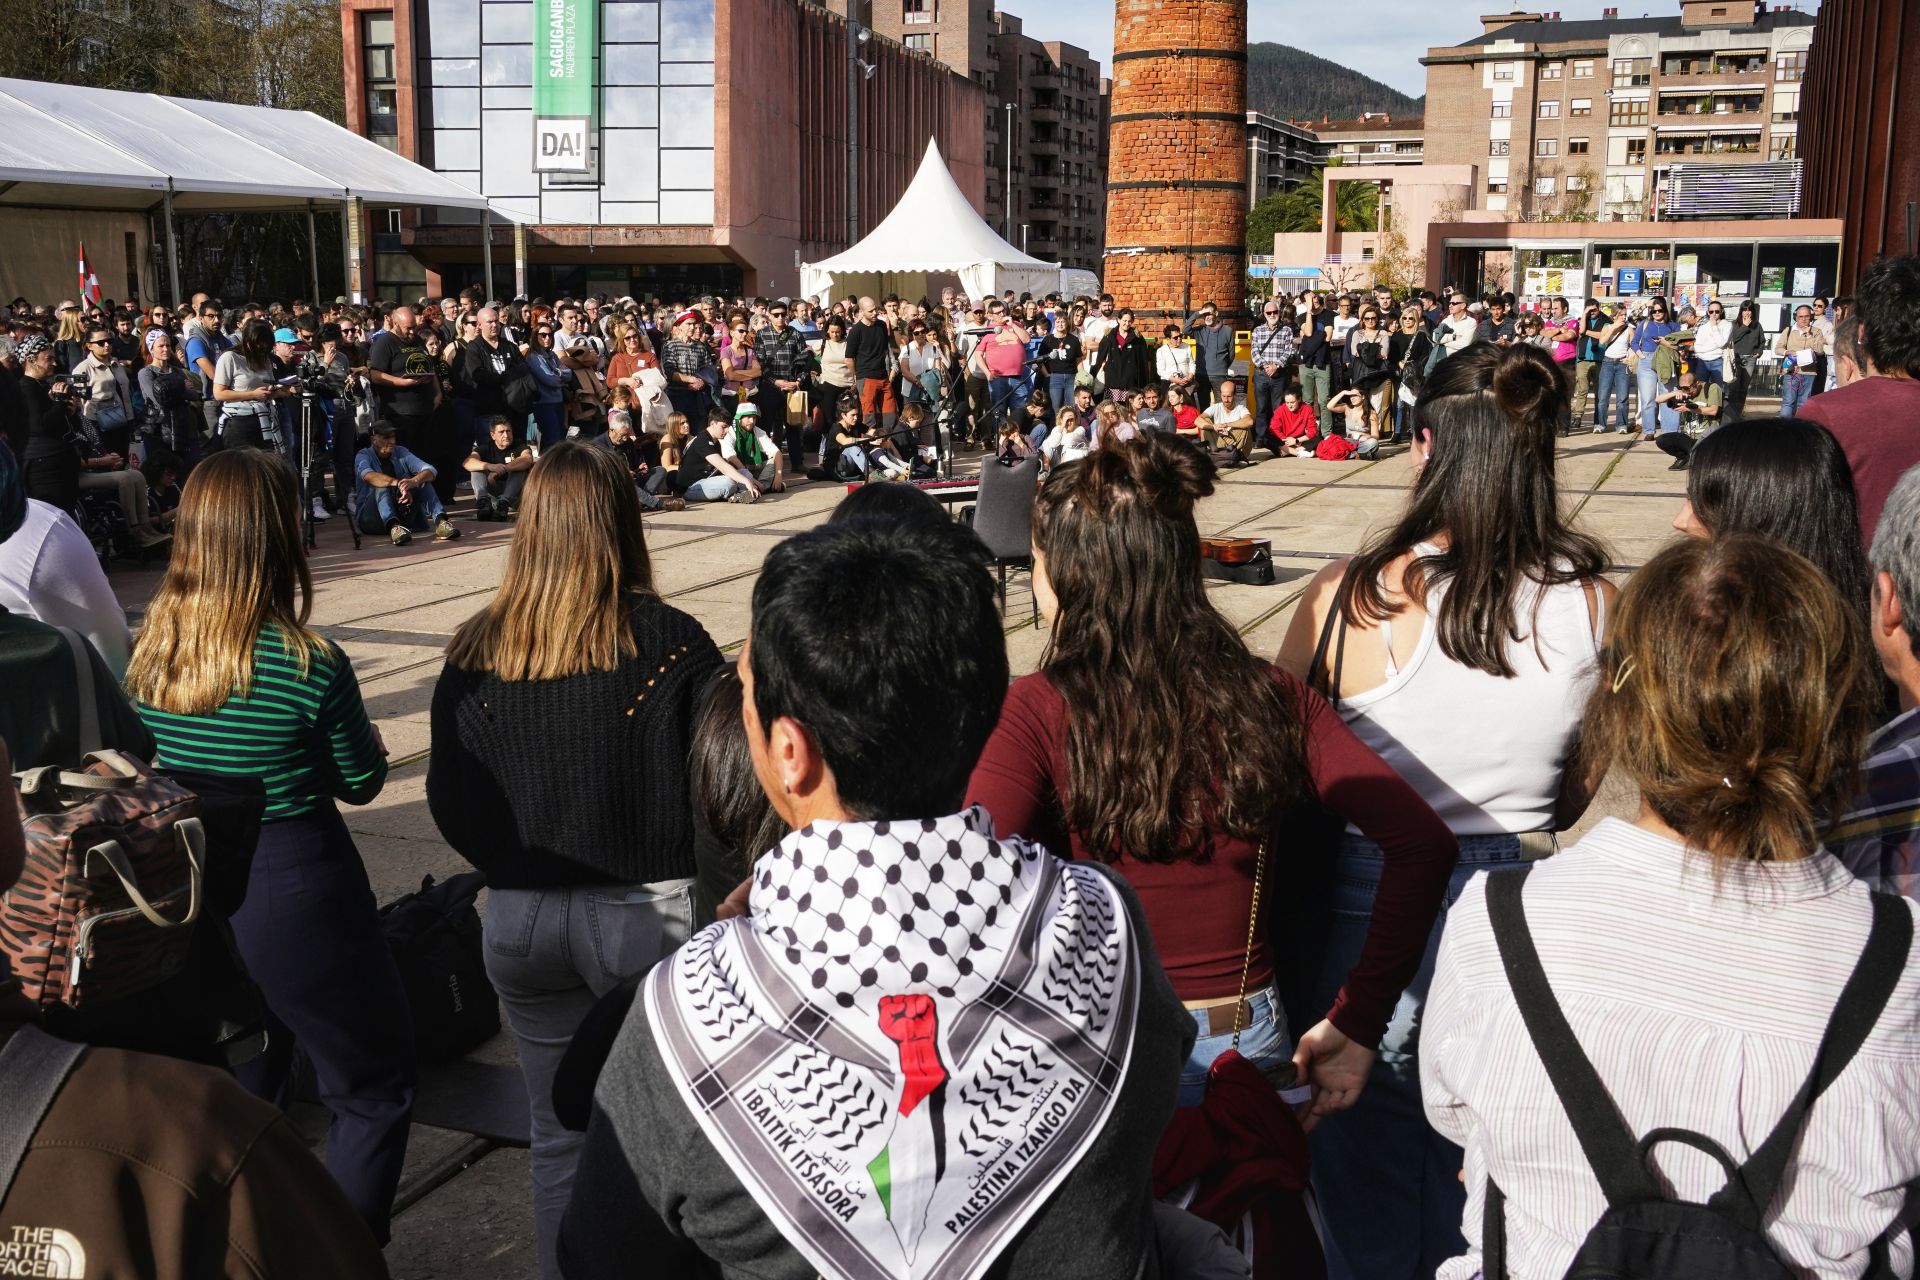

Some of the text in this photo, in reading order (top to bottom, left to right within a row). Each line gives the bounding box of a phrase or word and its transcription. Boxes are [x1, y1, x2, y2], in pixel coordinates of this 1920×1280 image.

[566, 4, 575, 35] PLAZA
[542, 132, 581, 157] DA!
[449, 974, 463, 1012] berria
[742, 1088, 859, 1222] IBAITIK ITSASORA
[944, 1077, 1086, 1235] PALESTINA IZANGO DA
[844, 1180, 867, 1200] من
[11, 1226, 53, 1244] THE
